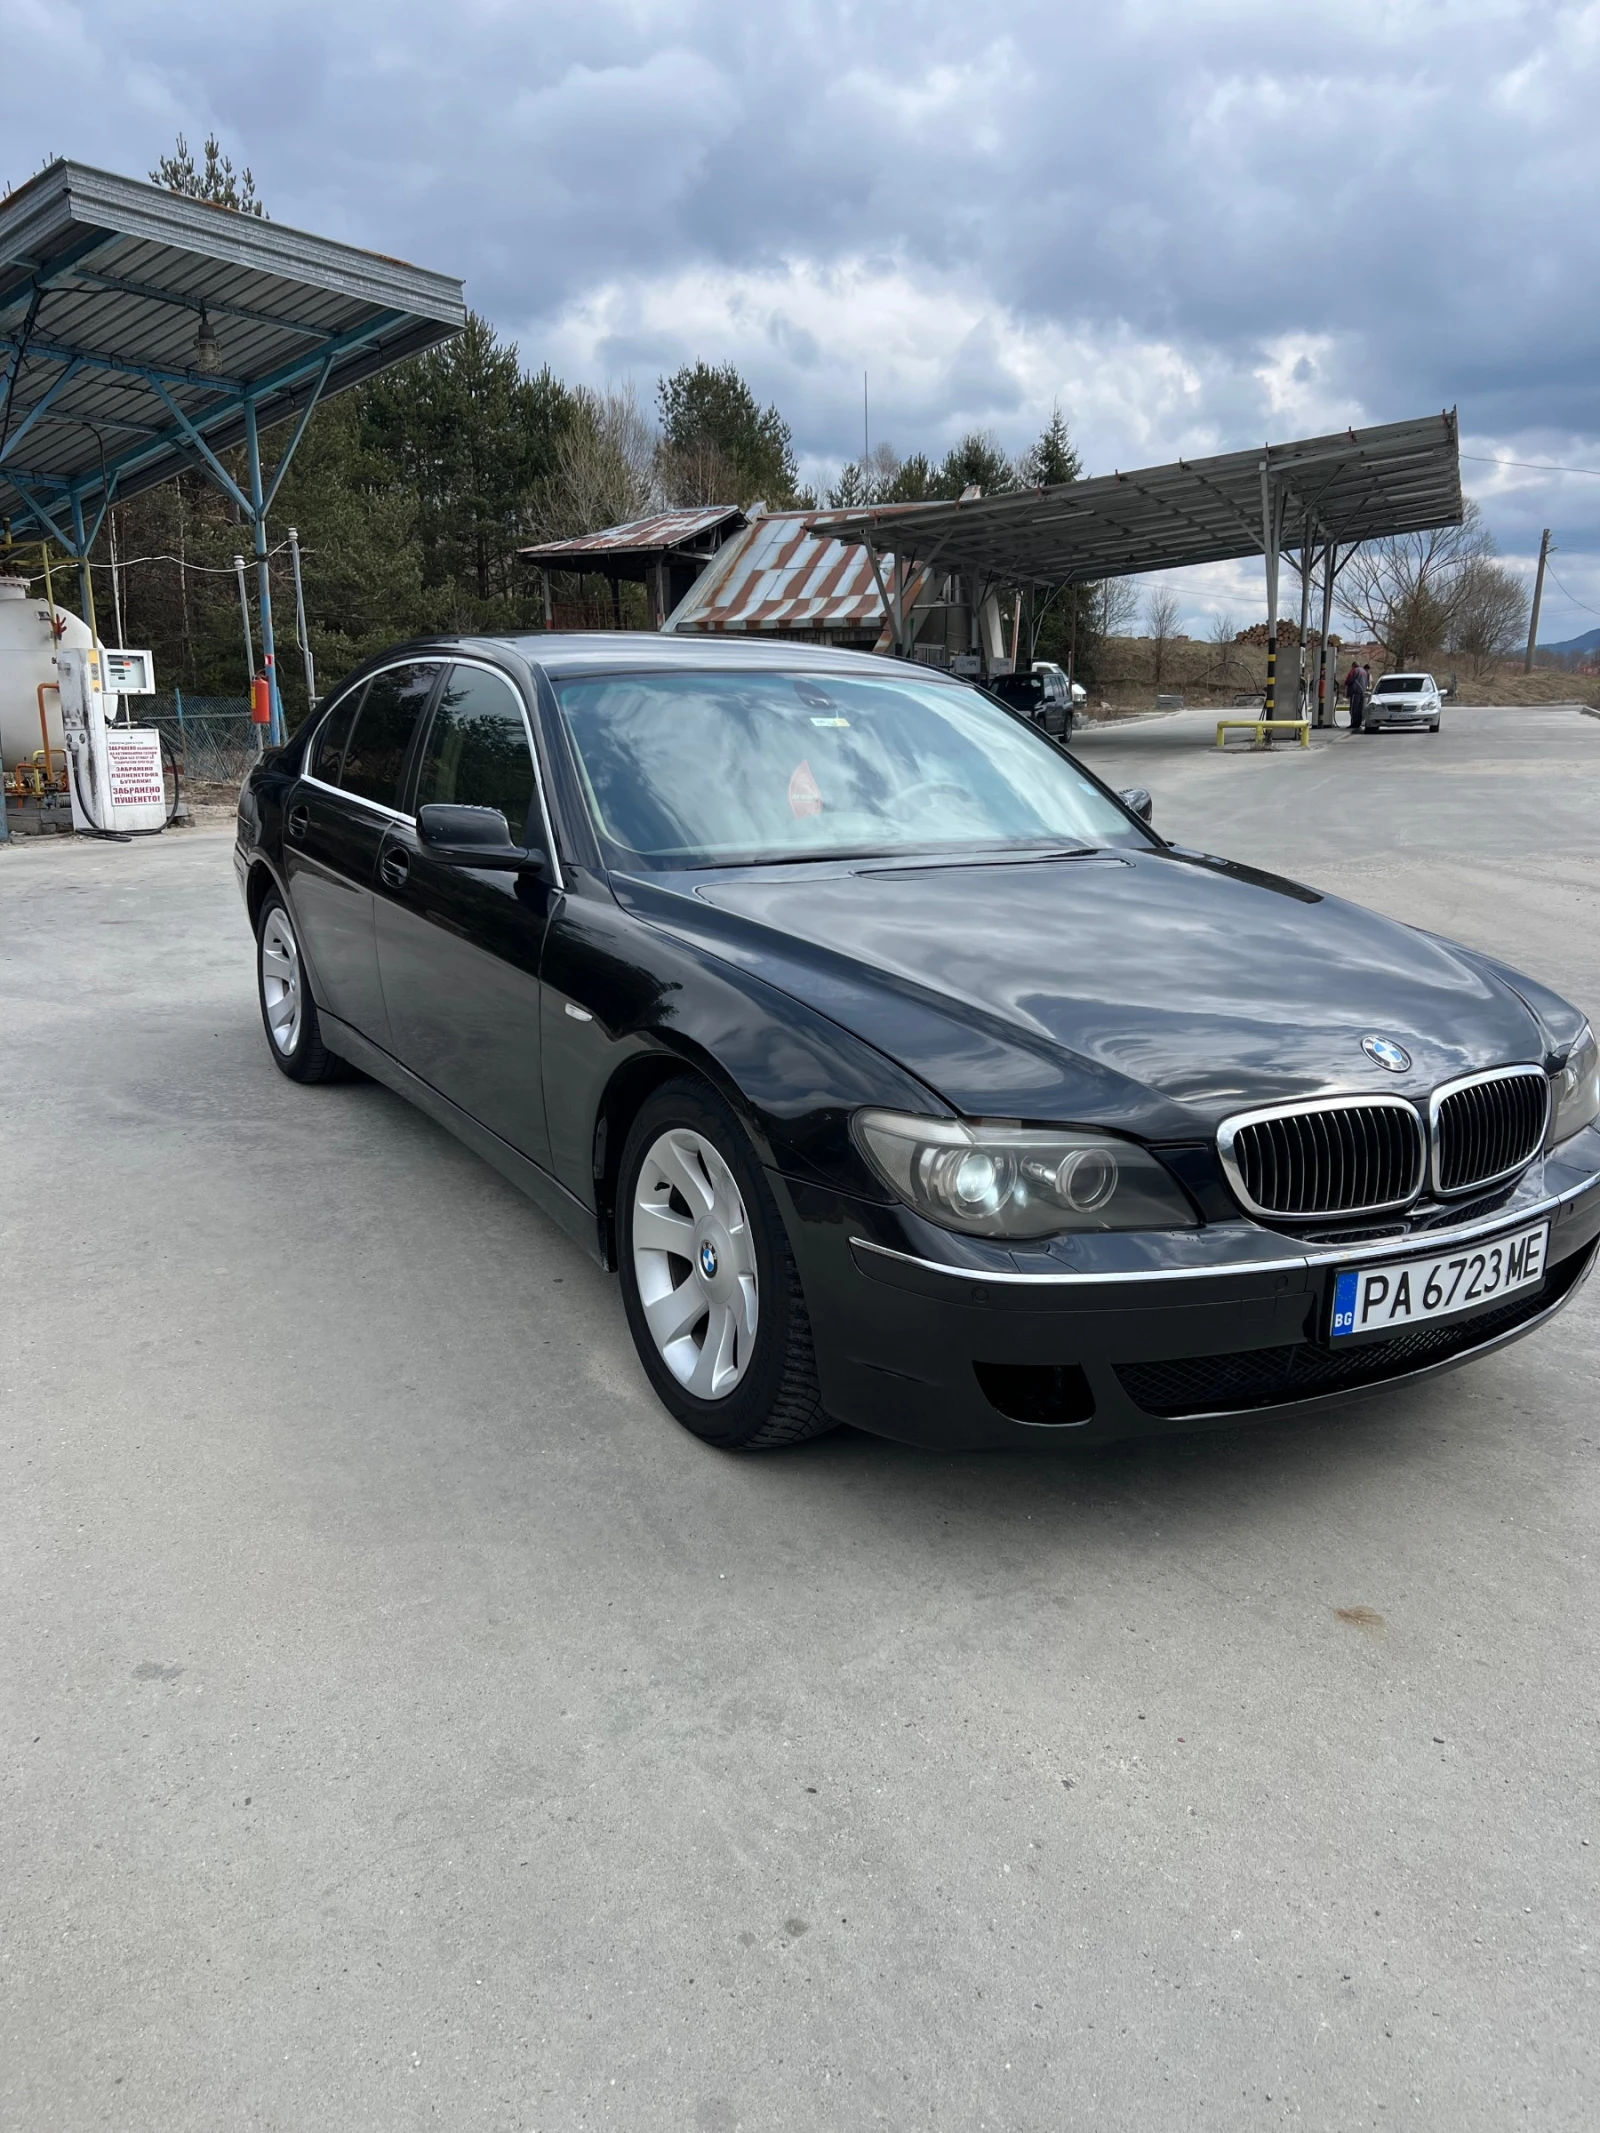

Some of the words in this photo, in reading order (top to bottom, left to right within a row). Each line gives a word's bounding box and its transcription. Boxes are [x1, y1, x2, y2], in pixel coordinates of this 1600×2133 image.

[112, 786, 160, 794] ЗАБРАНЕНО
[114, 796, 160, 804] ПУШЕНЕТО!
[1361, 1271, 1411, 1324] PA
[1422, 1248, 1502, 1310] 6723
[1505, 1231, 1543, 1287] ME
[1334, 1311, 1353, 1328] BG
